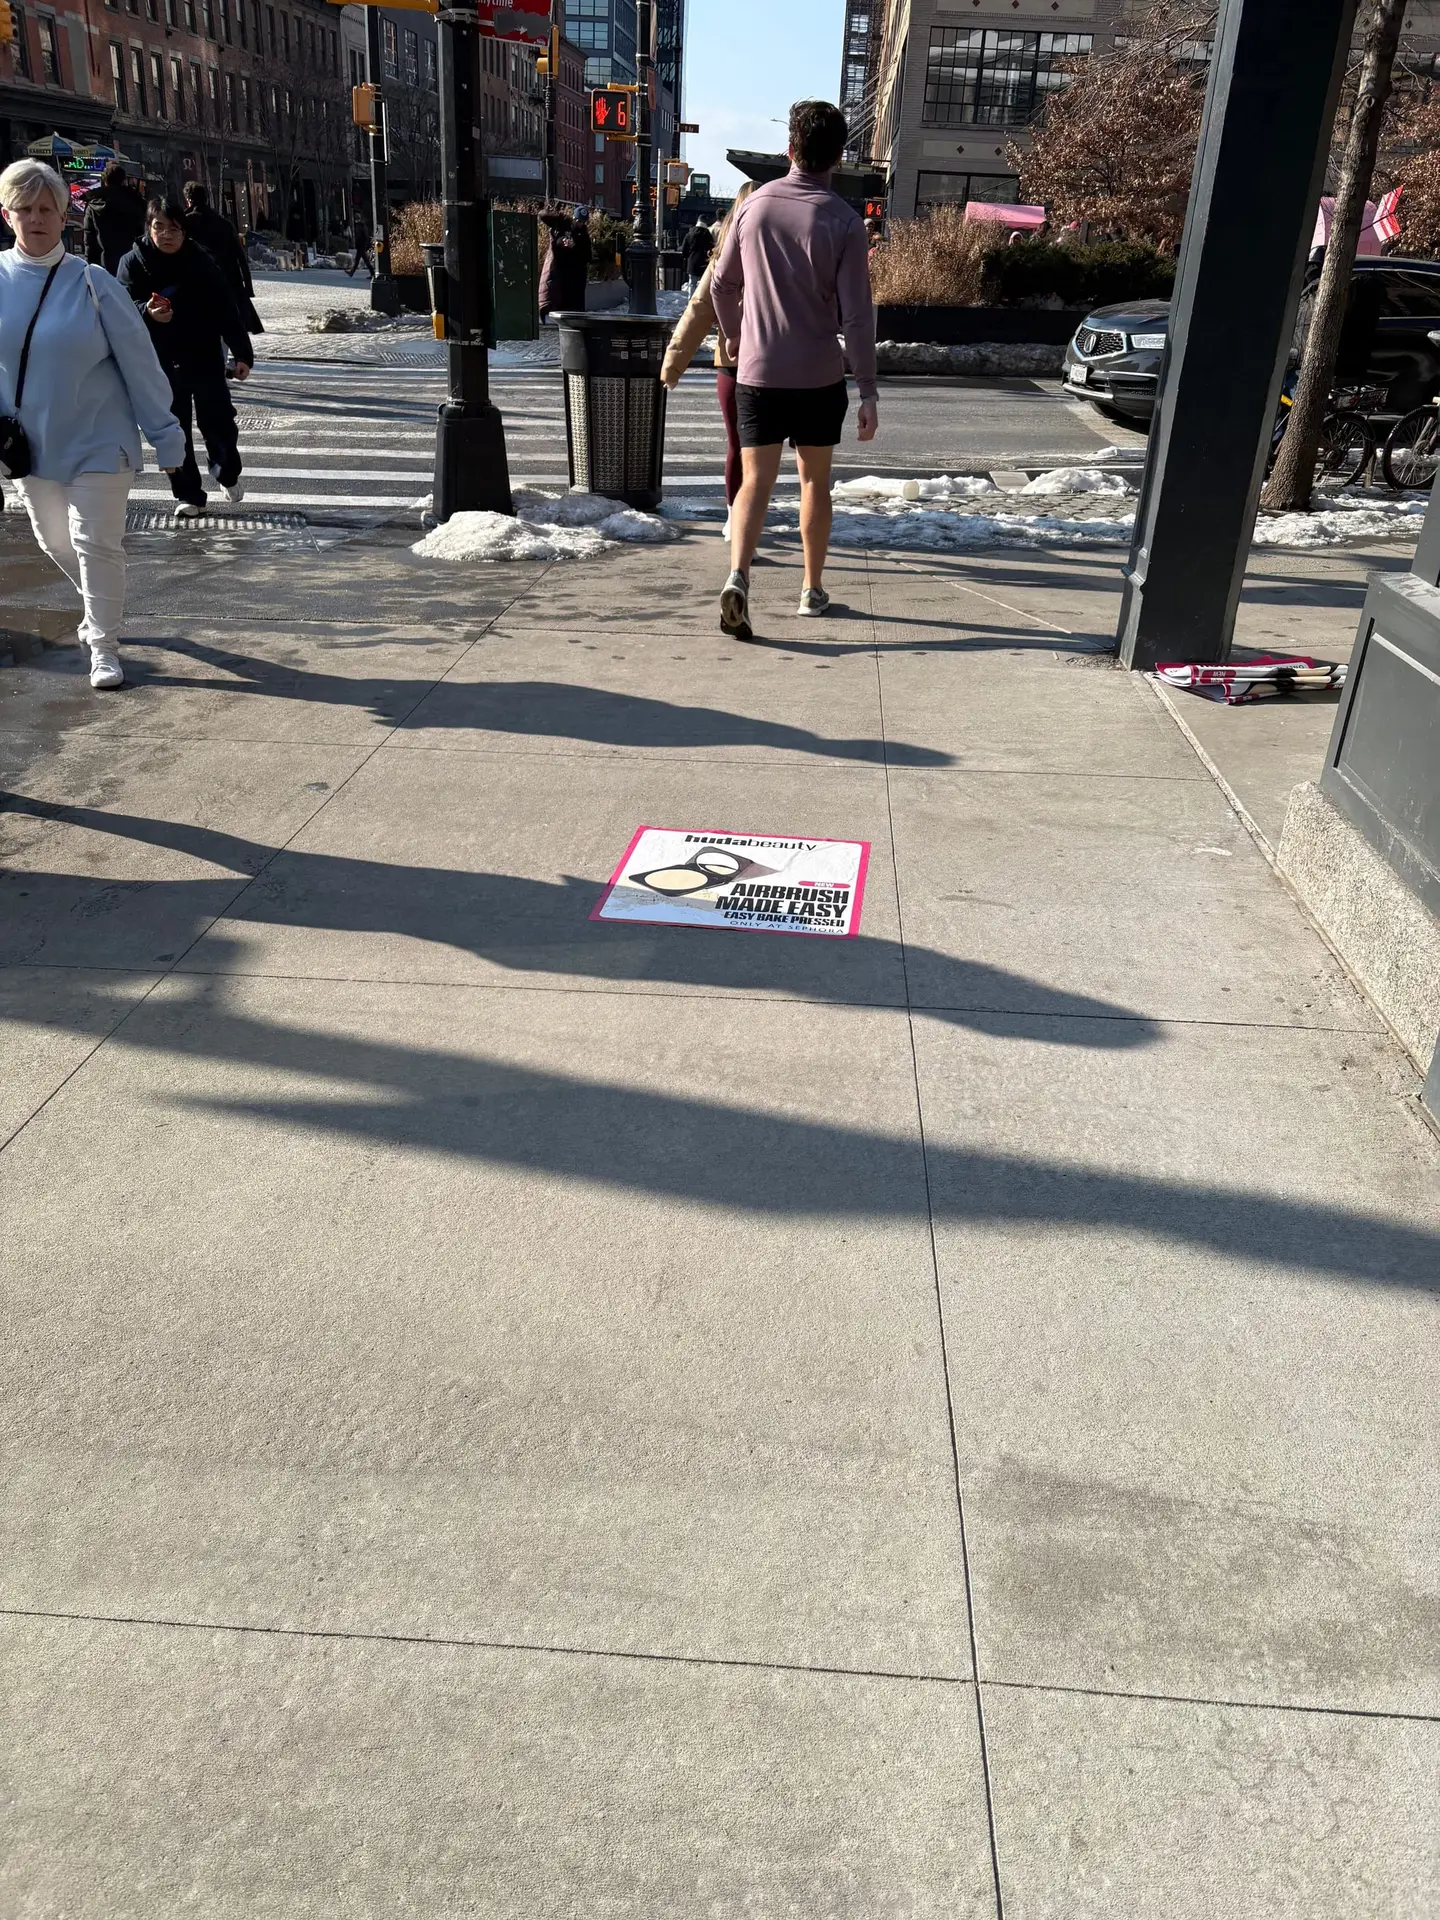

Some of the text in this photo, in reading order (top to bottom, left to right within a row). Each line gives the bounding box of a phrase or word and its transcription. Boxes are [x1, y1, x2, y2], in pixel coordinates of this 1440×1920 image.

[618, 101, 626, 126] 6
[876, 204, 881, 216] 6
[685, 834, 817, 851] hudabeauty
[730, 883, 849, 904] AIRBRUSH
[715, 896, 848, 918] MADE EASY
[724, 911, 845, 927] EASY BAKE PRESSED
[788, 925, 844, 934] SEPHORA
